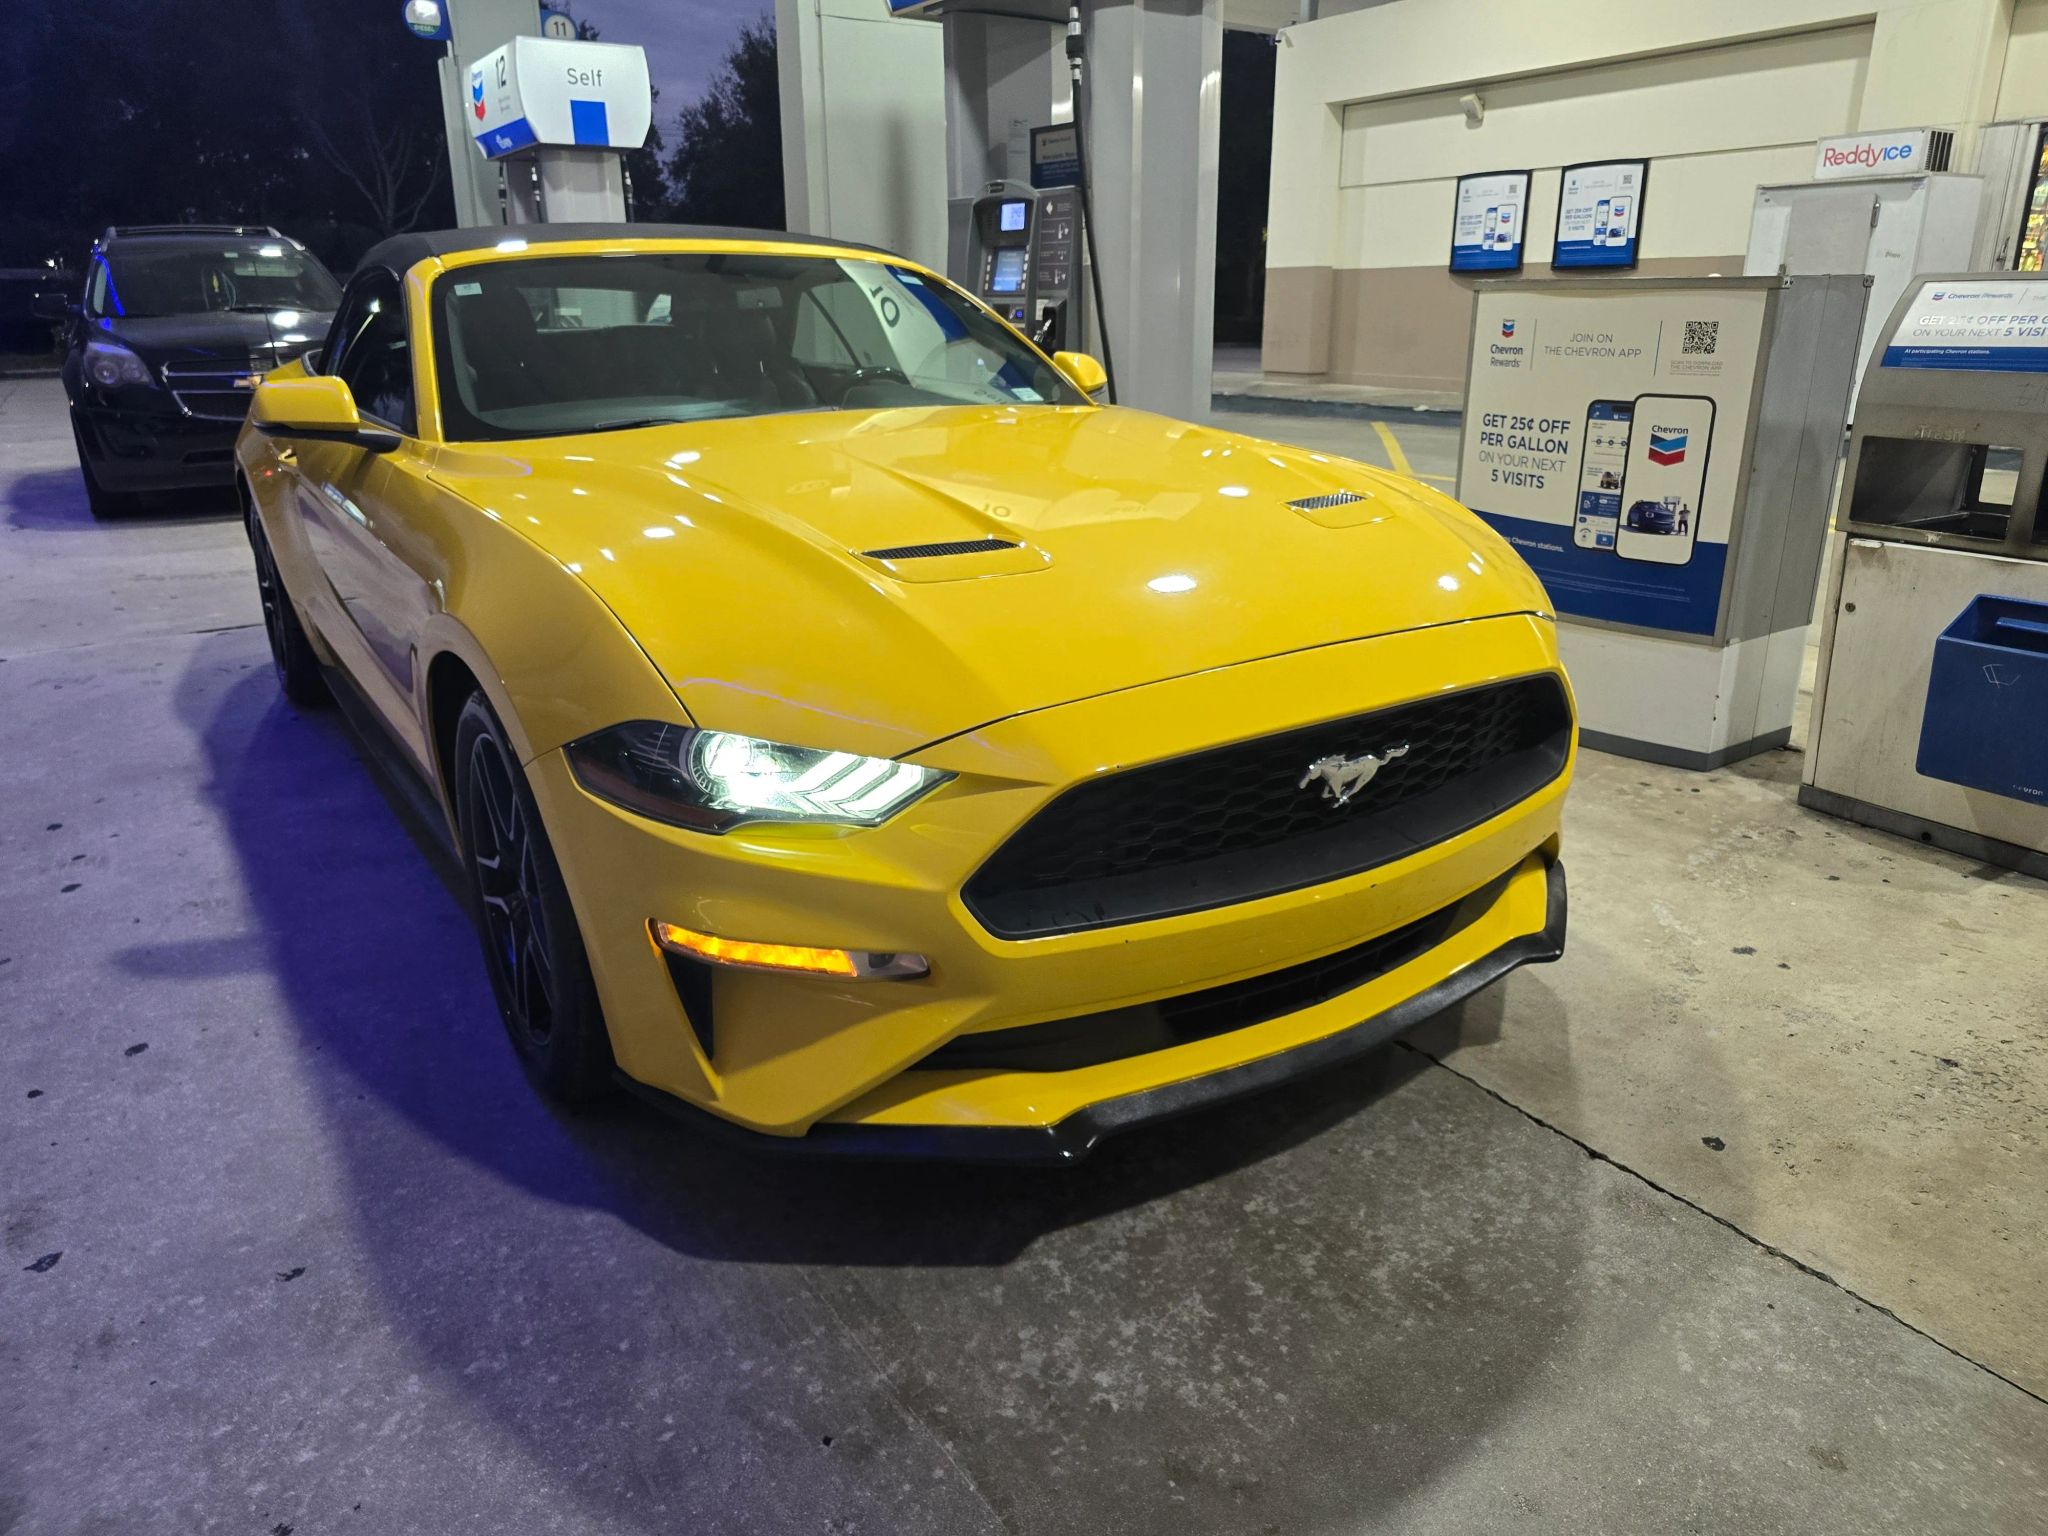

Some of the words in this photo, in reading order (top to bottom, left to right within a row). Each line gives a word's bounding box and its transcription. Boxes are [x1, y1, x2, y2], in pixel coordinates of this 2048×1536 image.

[553, 21, 568, 37] 11
[495, 55, 507, 89] 12
[567, 67, 602, 87] Self
[1919, 315, 1945, 325] GET
[1977, 315, 2007, 325] OFF
[2009, 315, 2038, 325] PER
[1569, 333, 1594, 343] JOIN
[1596, 334, 1613, 343] ON
[1912, 328, 1931, 337] ON
[1934, 328, 1966, 337] YOUR
[1967, 328, 2001, 337] NEXT
[2003, 327, 2014, 337] 5
[2018, 326, 2048, 337] VISI
[1490, 343, 1524, 355] Chevron
[1544, 345, 1562, 356] THE
[1564, 346, 1616, 357] CHEVRON
[1618, 348, 1642, 358] APP
[1490, 357, 1521, 368] Rewards
[1482, 413, 1507, 429] GET
[1510, 416, 1534, 431] 25¢
[1538, 418, 1571, 434] OFF
[1651, 424, 1689, 434] Chevron
[1480, 431, 1504, 448] PER
[1507, 435, 1569, 455] GALLON
[1479, 450, 1495, 464] ON
[1497, 452, 1529, 469] YOUR
[1531, 457, 1567, 473] NEXT
[1491, 469, 1499, 482] 5
[1502, 470, 1545, 489] VISITS
